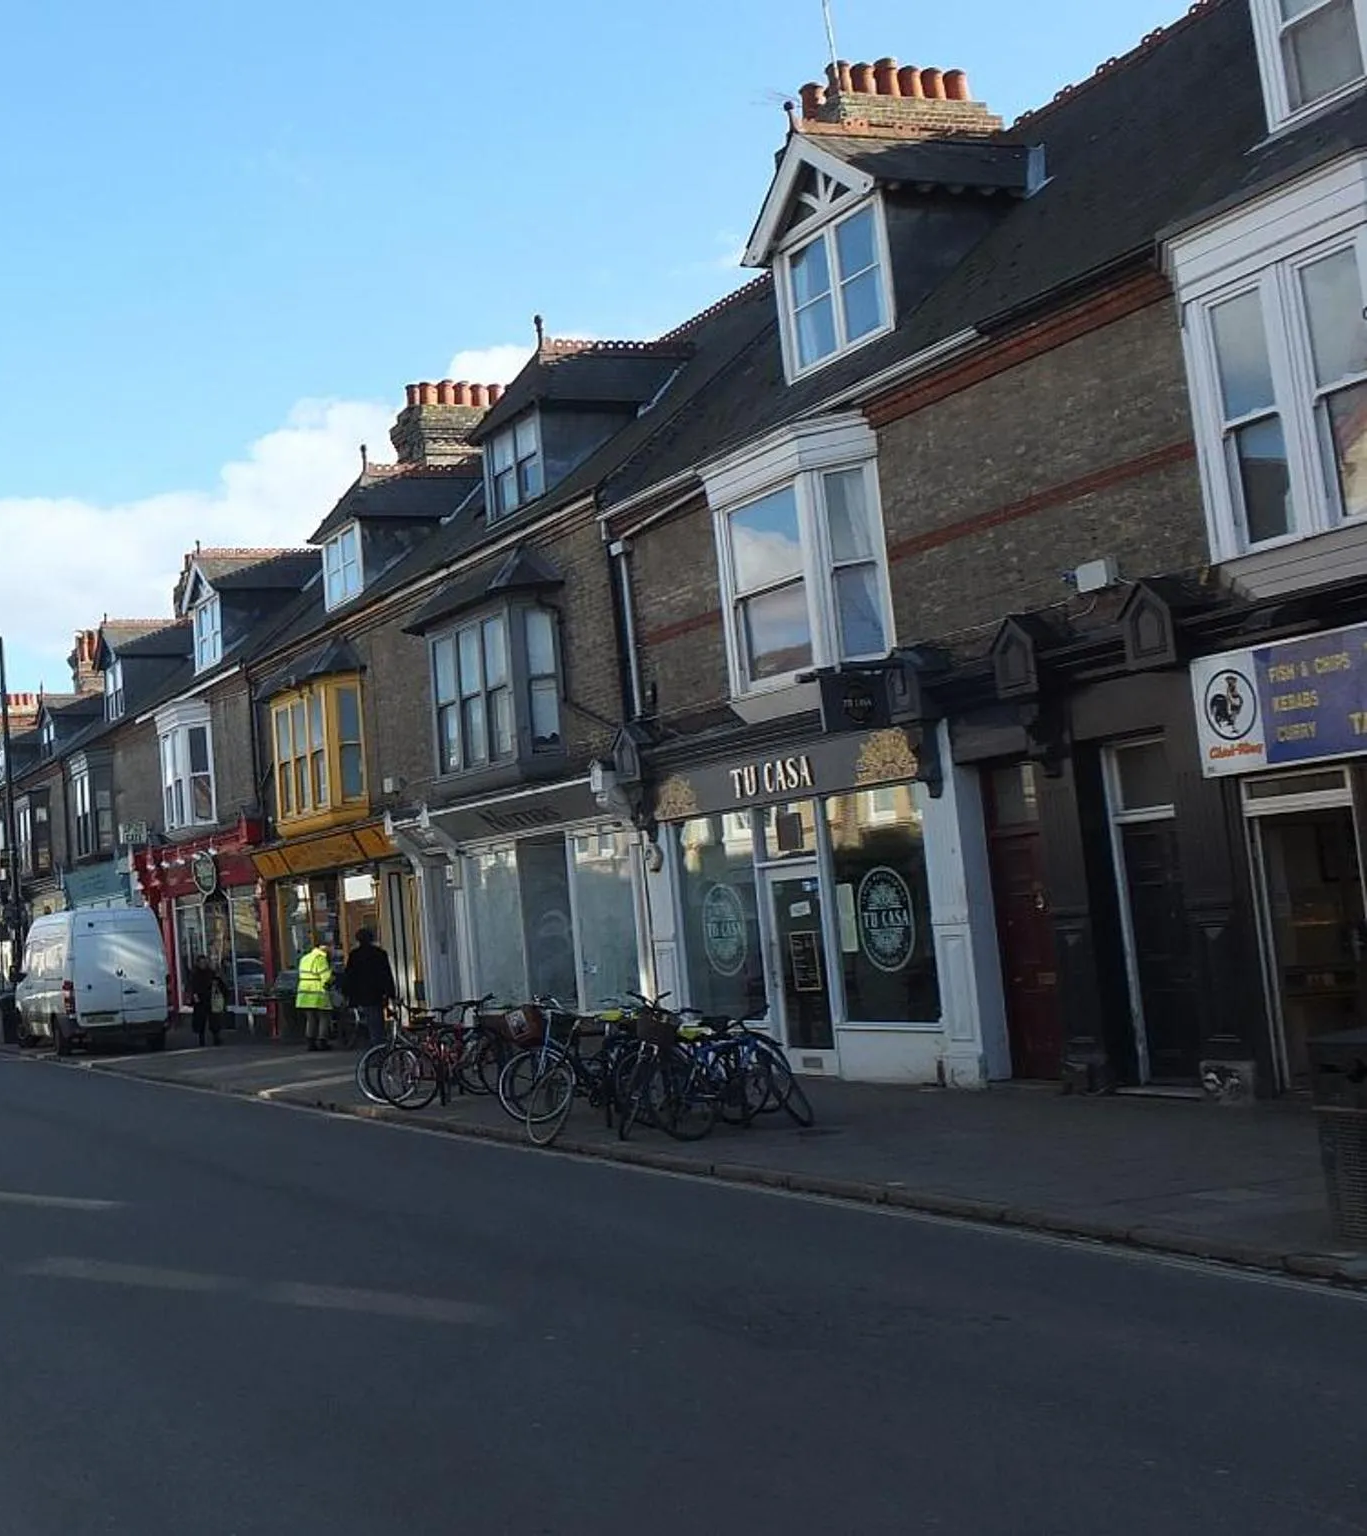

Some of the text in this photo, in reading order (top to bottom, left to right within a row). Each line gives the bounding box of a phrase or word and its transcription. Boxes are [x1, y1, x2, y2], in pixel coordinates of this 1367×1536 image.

[1268, 663, 1295, 683] FISH
[1314, 652, 1351, 674] CHIPS
[1273, 690, 1319, 712] KEBABS
[1277, 721, 1317, 742] CURRY
[729, 755, 814, 799] TU CASA
[862, 908, 909, 928] TU CASA
